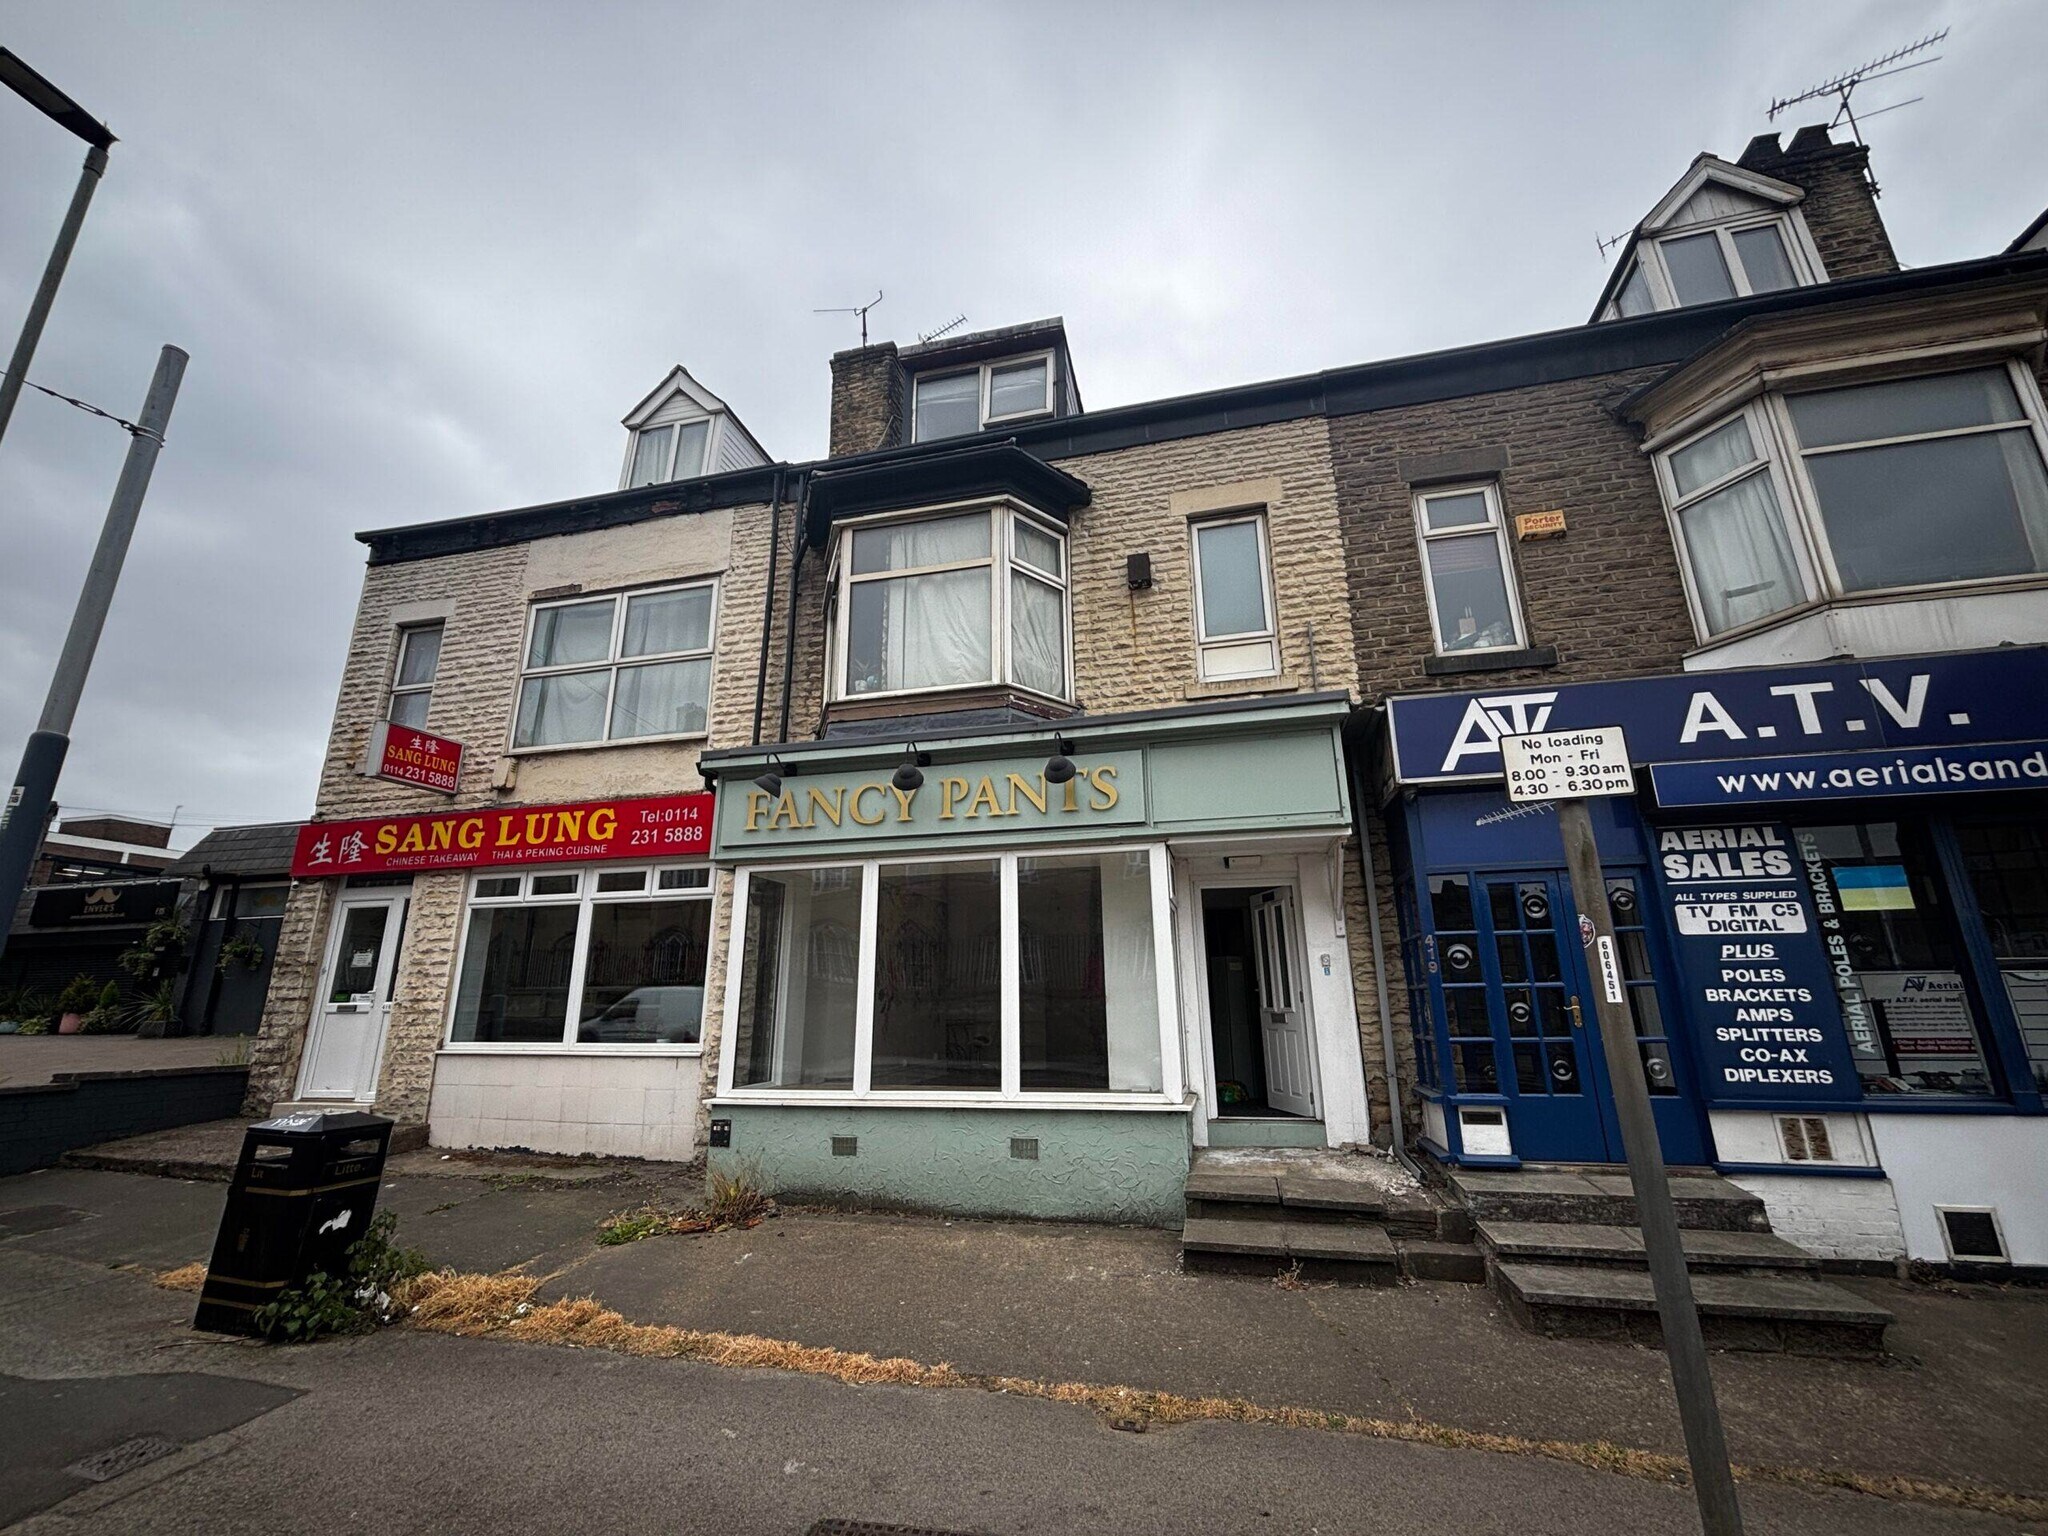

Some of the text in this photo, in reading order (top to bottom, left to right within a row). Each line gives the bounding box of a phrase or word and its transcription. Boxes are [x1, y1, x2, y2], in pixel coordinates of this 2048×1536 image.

[1524, 515, 1561, 525] Porter
[1524, 522, 1563, 530] SECURITY
[1679, 674, 1971, 743] A.T.V.
[410, 735, 440, 754] 生隆
[1521, 734, 1604, 750] No loading
[387, 745, 456, 774] SANG LUNG
[1530, 754, 1561, 765] Mon
[1580, 749, 1600, 760] Fri
[383, 763, 455, 788] 0114 231 5888
[1512, 769, 1546, 782] 8.00
[940, 765, 1119, 820] PANTS
[1514, 783, 1548, 796] 4.30
[744, 782, 920, 831] FANCY
[640, 807, 698, 824] Tel:0114
[375, 808, 618, 854] SANG LUNG
[631, 826, 703, 845] 231 5888
[1660, 826, 1786, 852] AERIAL
[307, 830, 369, 867] 生隆
[386, 844, 608, 867] CHINESE TAKEAWAY THAI & PEKING CUISINE
[1663, 850, 1792, 879] SALES
[1675, 890, 1797, 901] ALL TYPES SUPPLIED
[1686, 904, 1799, 918] TV FM C5
[1708, 919, 1785, 932] DIGITAL
[1721, 944, 1775, 958] PLUS
[1800, 832, 1875, 1054] AERIAL POLES & BRACKETS
[1601, 940, 1617, 999] 606451
[1721, 968, 1786, 982] POLES
[1705, 988, 1812, 1002] BRACKETS
[1736, 1008, 1794, 1022] AMPS
[1716, 1027, 1823, 1042] SPLITTERS
[1740, 1047, 1809, 1063] CO-AX
[1724, 1068, 1834, 1084] DIPLEXERS
